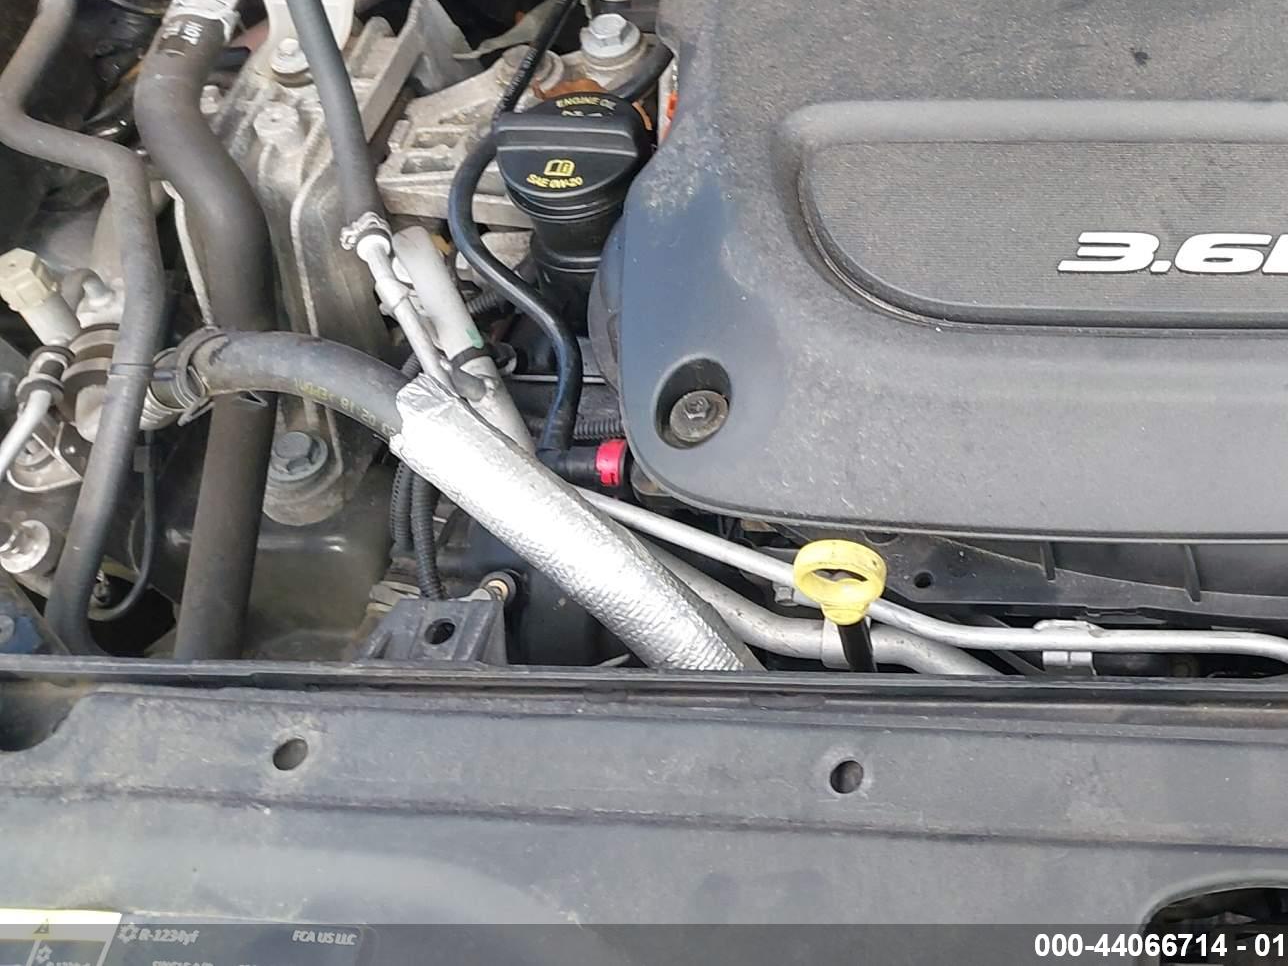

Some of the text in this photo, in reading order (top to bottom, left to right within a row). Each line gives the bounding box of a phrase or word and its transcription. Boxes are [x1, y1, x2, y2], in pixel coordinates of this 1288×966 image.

[526, 174, 549, 188] SAE
[138, 928, 200, 946] R-1234yf
[292, 929, 358, 946] FCA US LLC
